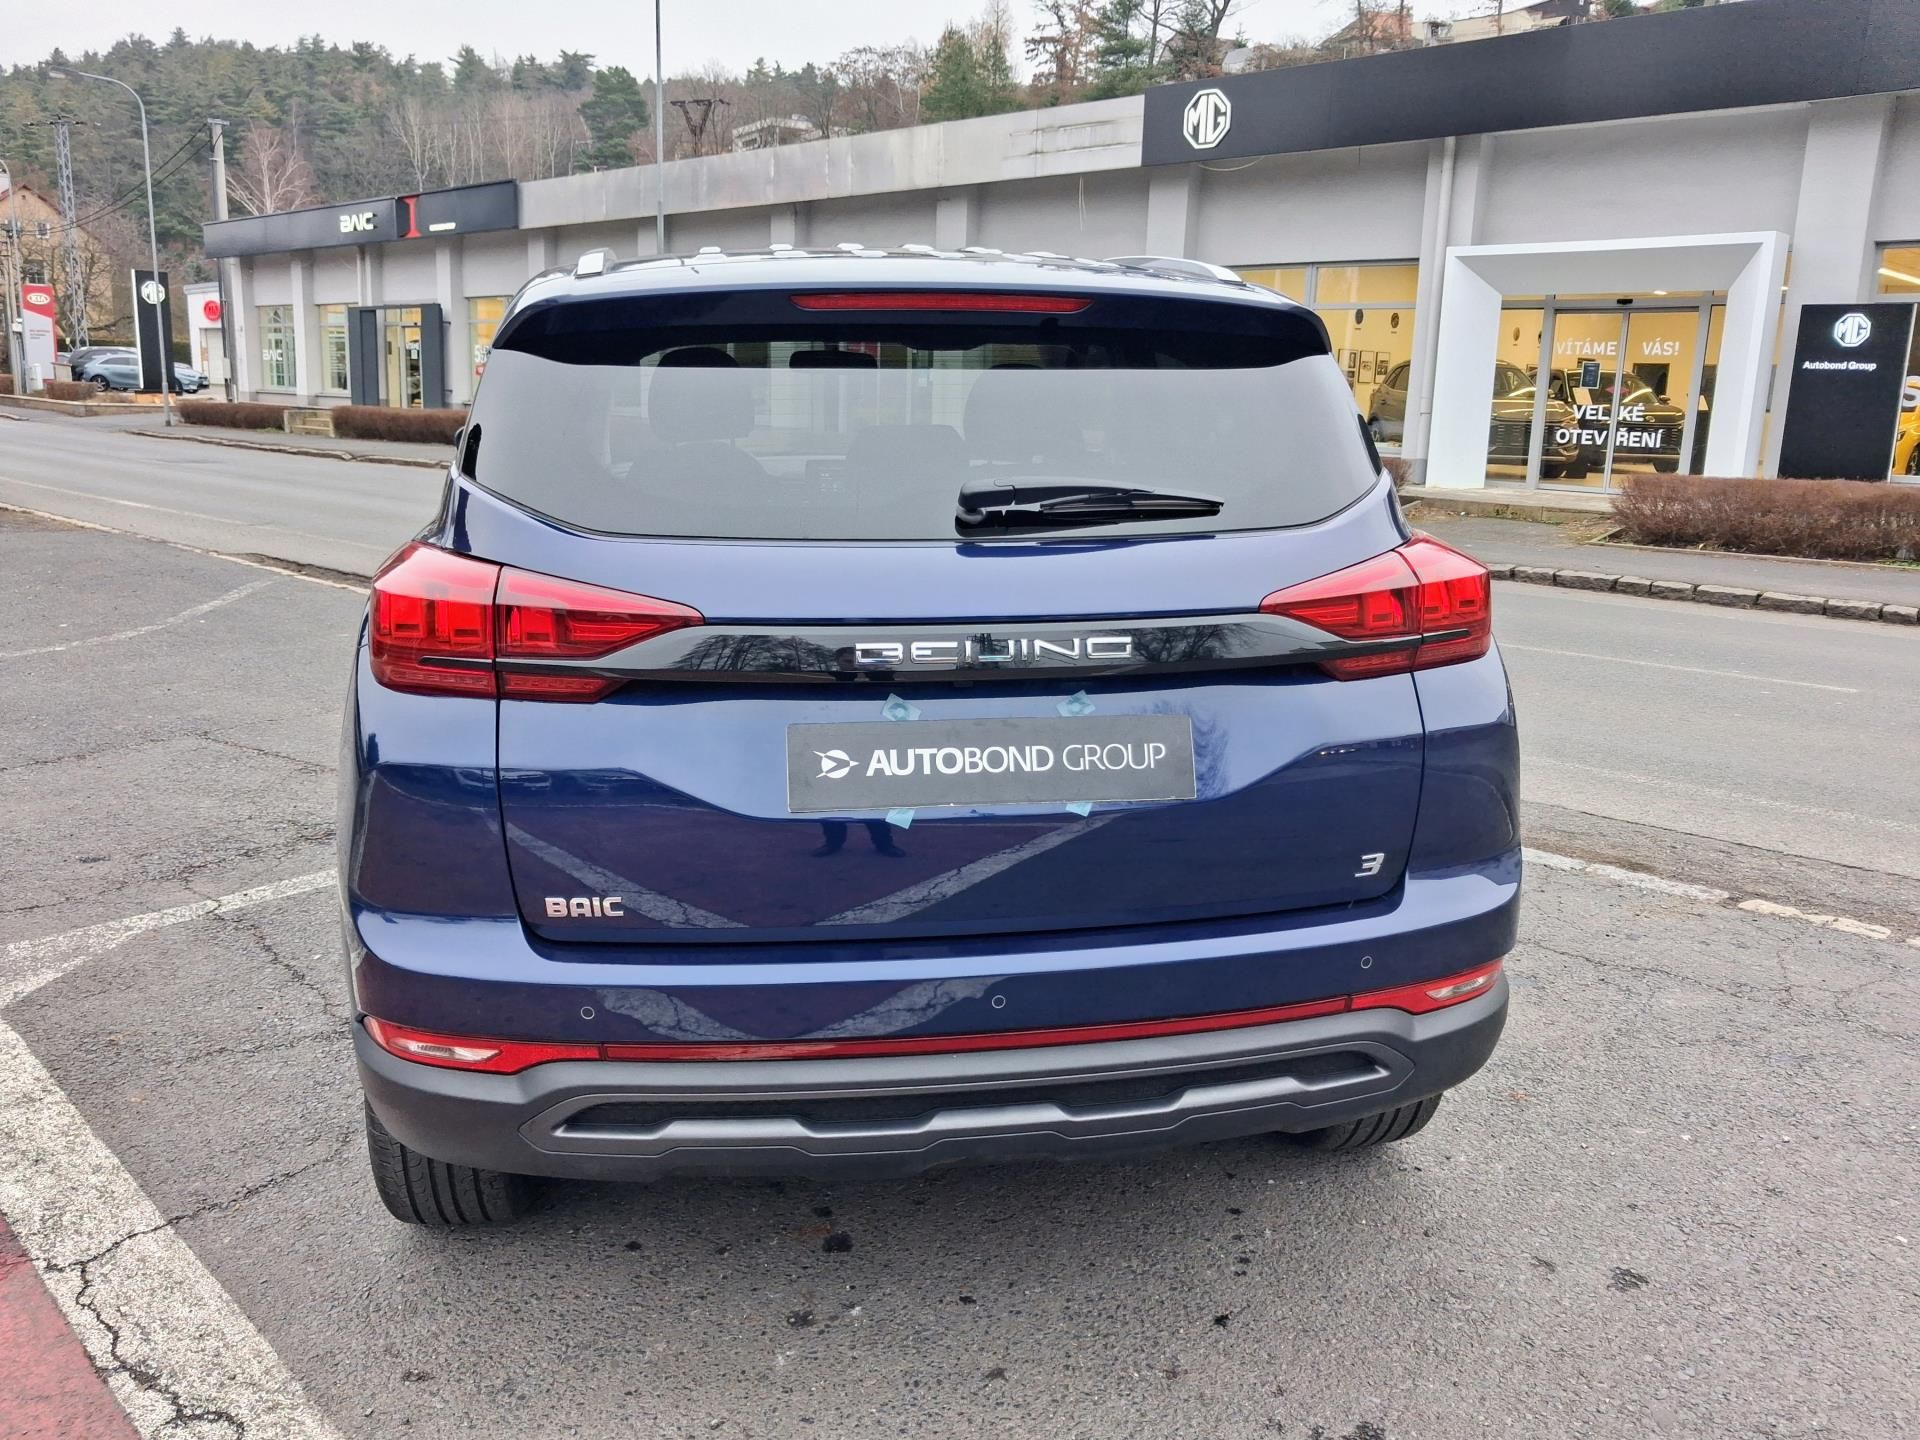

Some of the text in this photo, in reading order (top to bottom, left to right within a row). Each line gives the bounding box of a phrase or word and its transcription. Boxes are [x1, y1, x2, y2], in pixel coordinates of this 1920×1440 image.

[1186, 92, 1228, 144] MG
[340, 212, 374, 233] BAIC
[1838, 315, 1869, 345] MG
[1555, 337, 1680, 355] VÍTÁME VÁS!
[1802, 361, 1877, 371] Autobond Group
[1573, 402, 1645, 422] VELKÉ
[1555, 427, 1664, 449] OTEVŘENÍ
[855, 636, 1133, 665] BEIJING
[865, 742, 1167, 778] AUTOBOND GROUP
[1354, 853, 1385, 877] 3
[544, 896, 624, 918] BAIC
